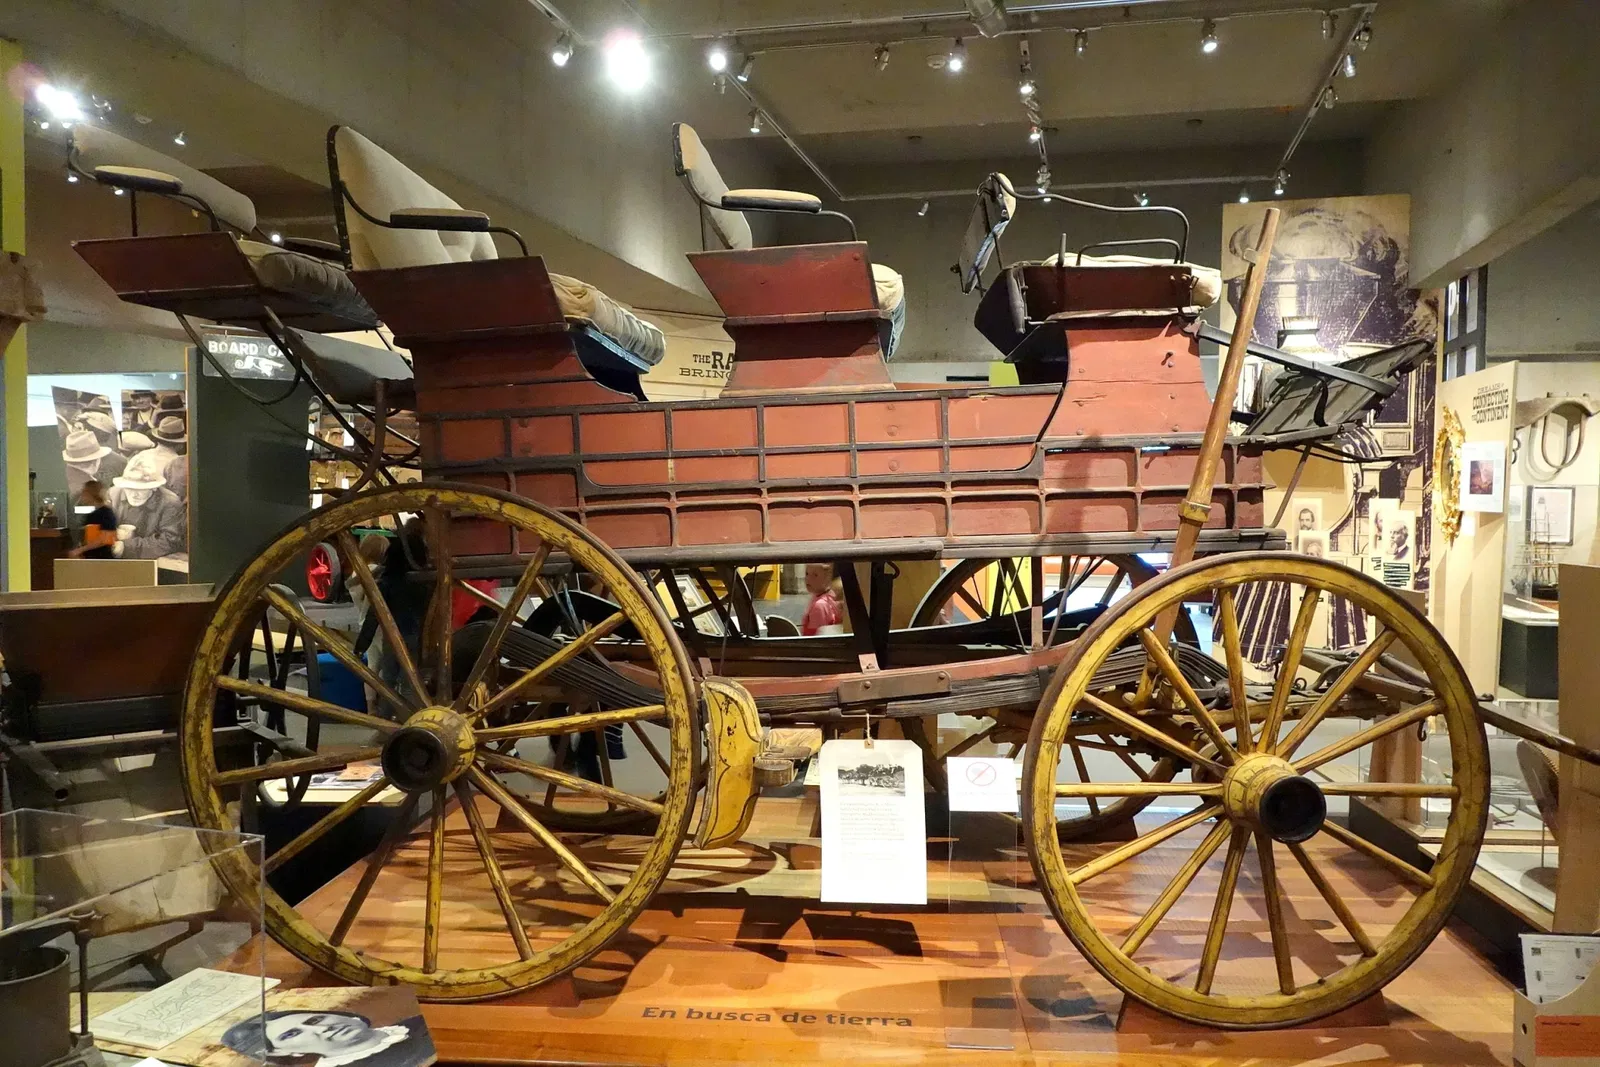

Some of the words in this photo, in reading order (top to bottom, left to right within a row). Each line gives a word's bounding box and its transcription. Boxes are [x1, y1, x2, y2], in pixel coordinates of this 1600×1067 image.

[208, 341, 258, 355] BOARD
[692, 354, 710, 363] THE
[1473, 389, 1508, 410] CONNECTING
[1476, 404, 1509, 423] CONTINENT
[641, 1007, 677, 1018] En
[686, 1008, 771, 1022] busca
[781, 1012, 817, 1024] de
[826, 1013, 912, 1027] tierra
